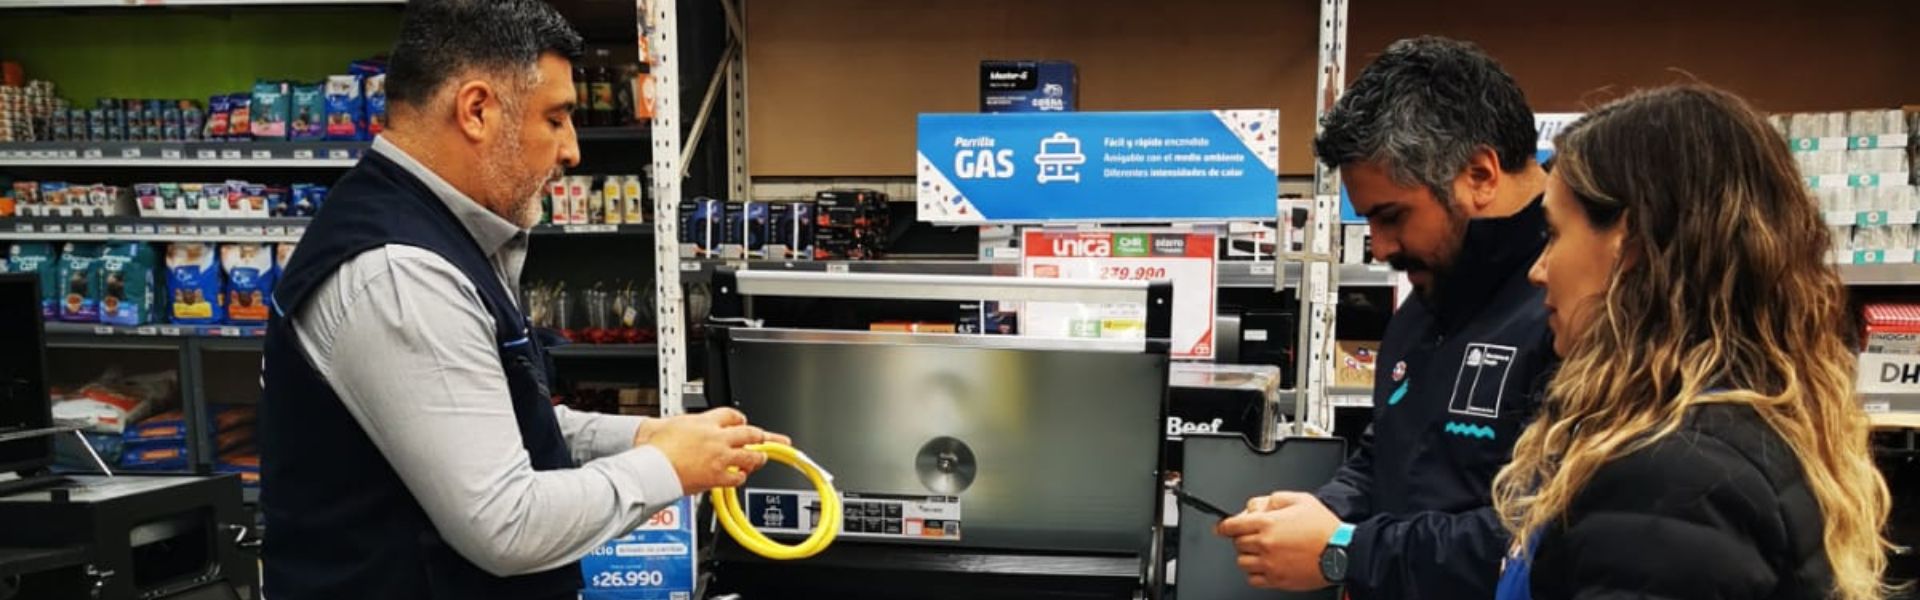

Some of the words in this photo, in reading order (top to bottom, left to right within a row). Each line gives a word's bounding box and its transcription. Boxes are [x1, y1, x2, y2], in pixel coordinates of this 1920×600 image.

[954, 136, 996, 149] Parrilla
[954, 148, 1015, 179] GAS
[1173, 153, 1202, 162] medio
[1203, 153, 1245, 162] ambiente
[1103, 168, 1148, 177] Diferentes
[1149, 168, 1207, 177] intensidades
[1208, 168, 1219, 177] de
[592, 570, 664, 587] $26.990
